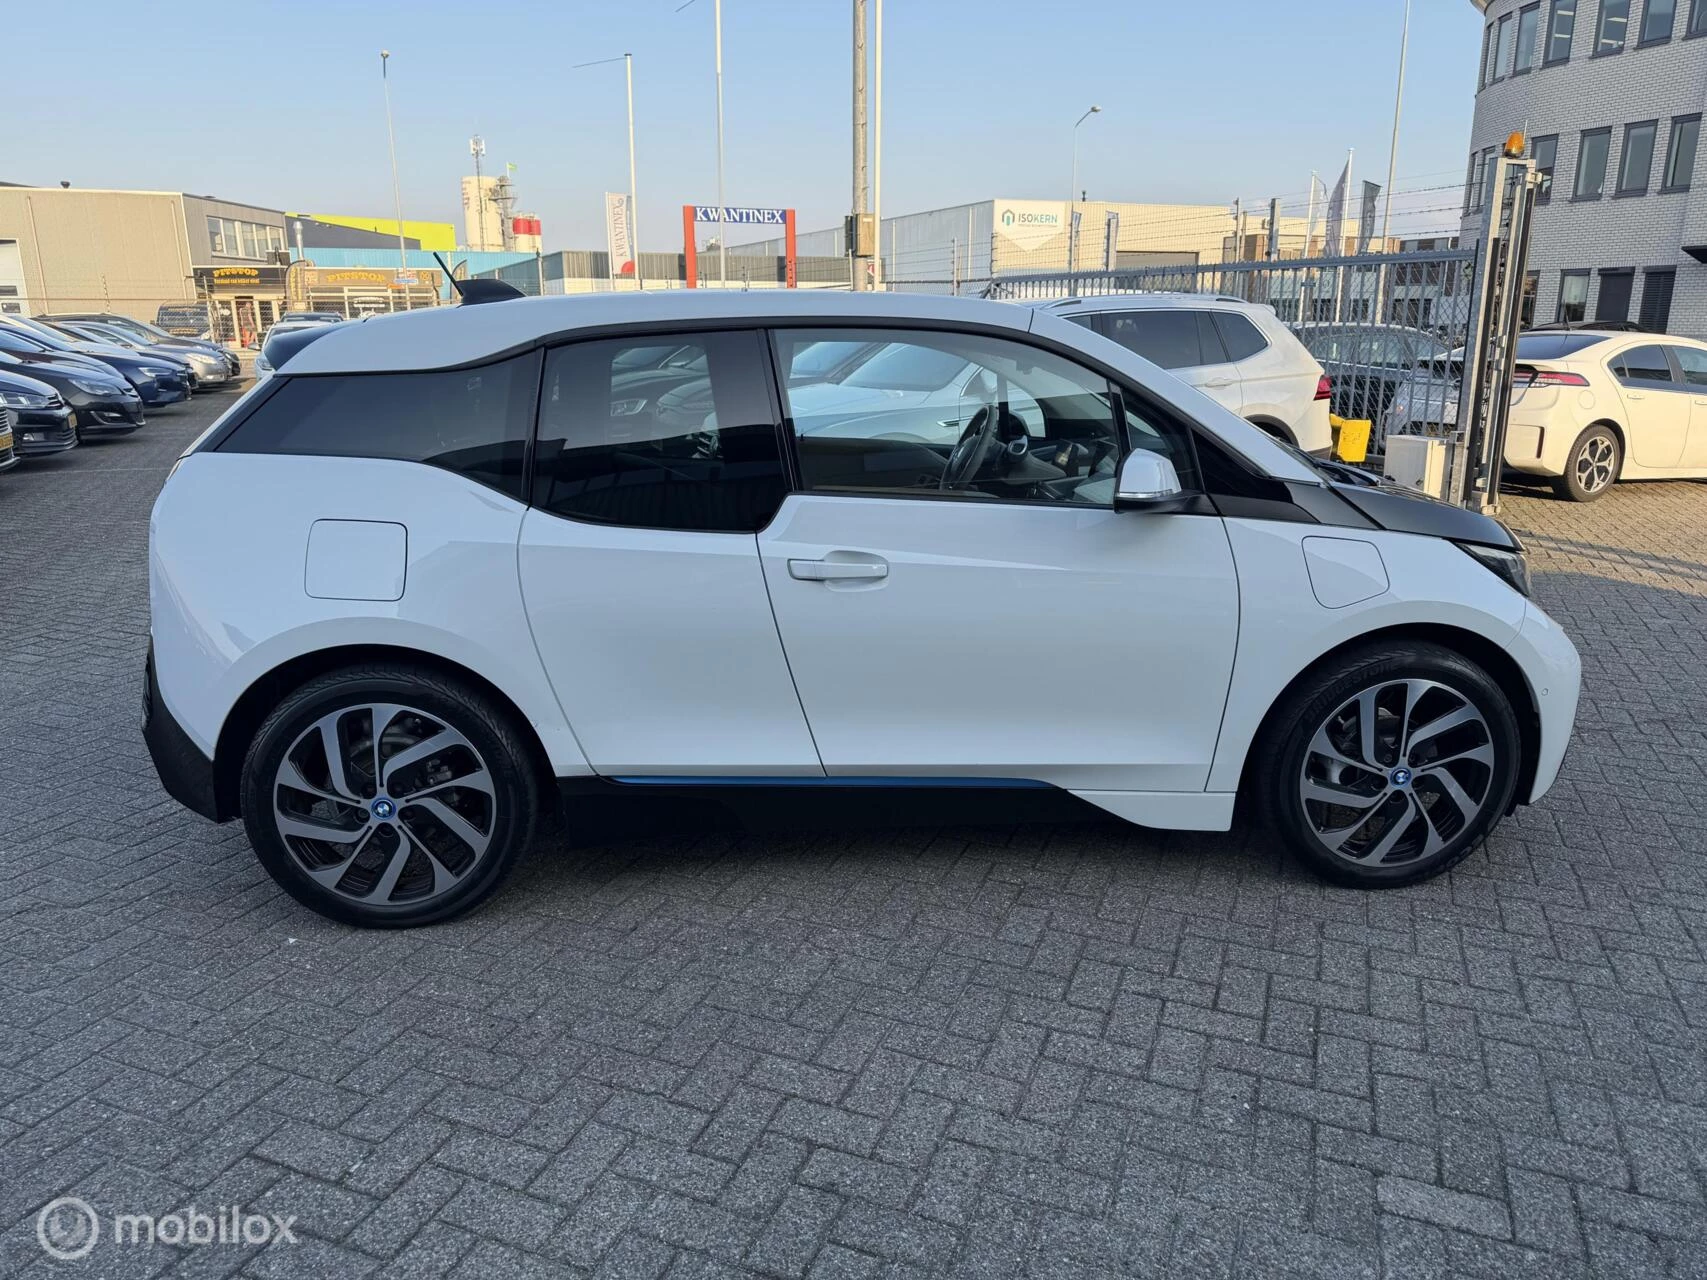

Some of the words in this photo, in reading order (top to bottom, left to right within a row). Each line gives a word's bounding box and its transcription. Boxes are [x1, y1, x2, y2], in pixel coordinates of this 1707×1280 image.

[695, 207, 783, 224] KWANTINEX
[1018, 213, 1058, 224] ISOKERN
[213, 267, 259, 278] PITSTOP
[326, 271, 385, 283] PITSTOP
